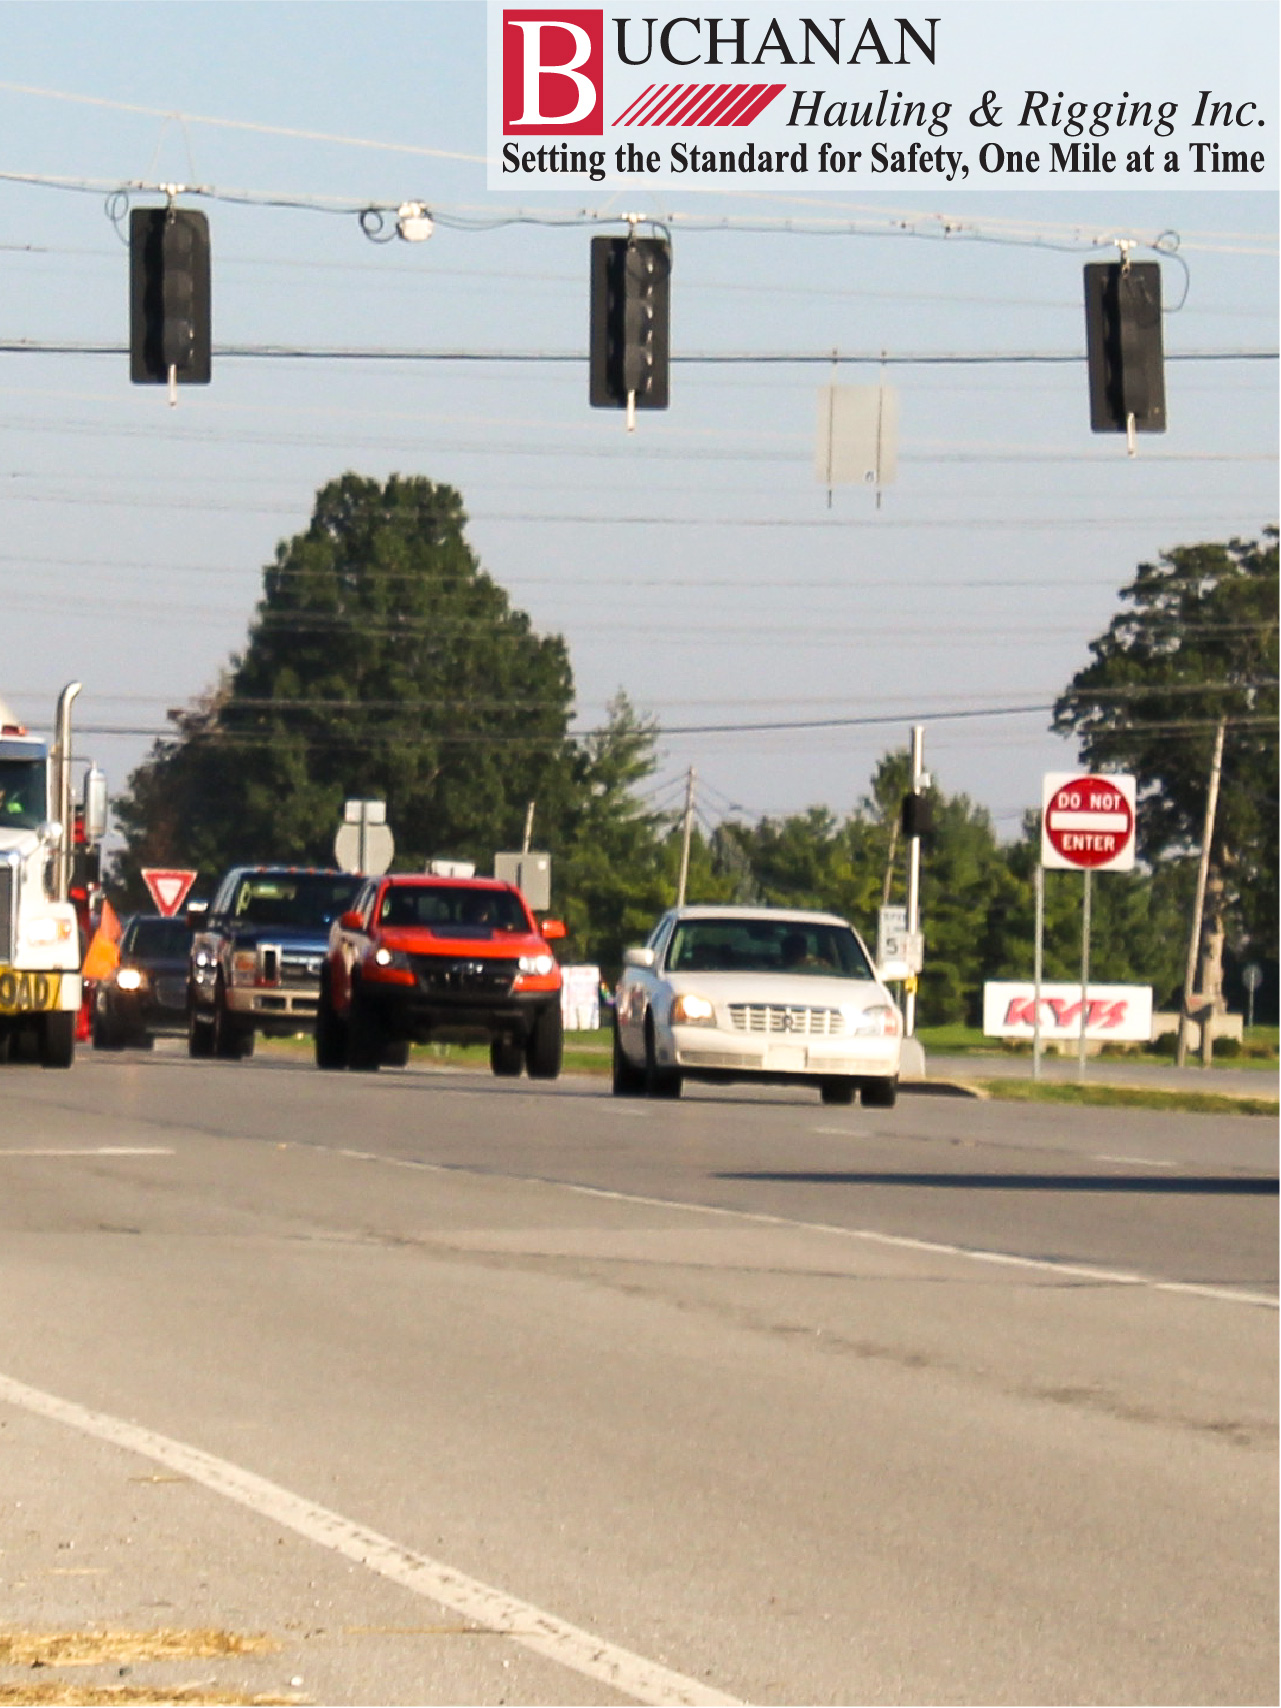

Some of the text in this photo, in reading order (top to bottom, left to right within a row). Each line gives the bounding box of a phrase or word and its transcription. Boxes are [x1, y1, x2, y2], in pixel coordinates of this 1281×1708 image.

[1058, 792, 1120, 810] DO NOT
[1063, 834, 1115, 851] ENTER
